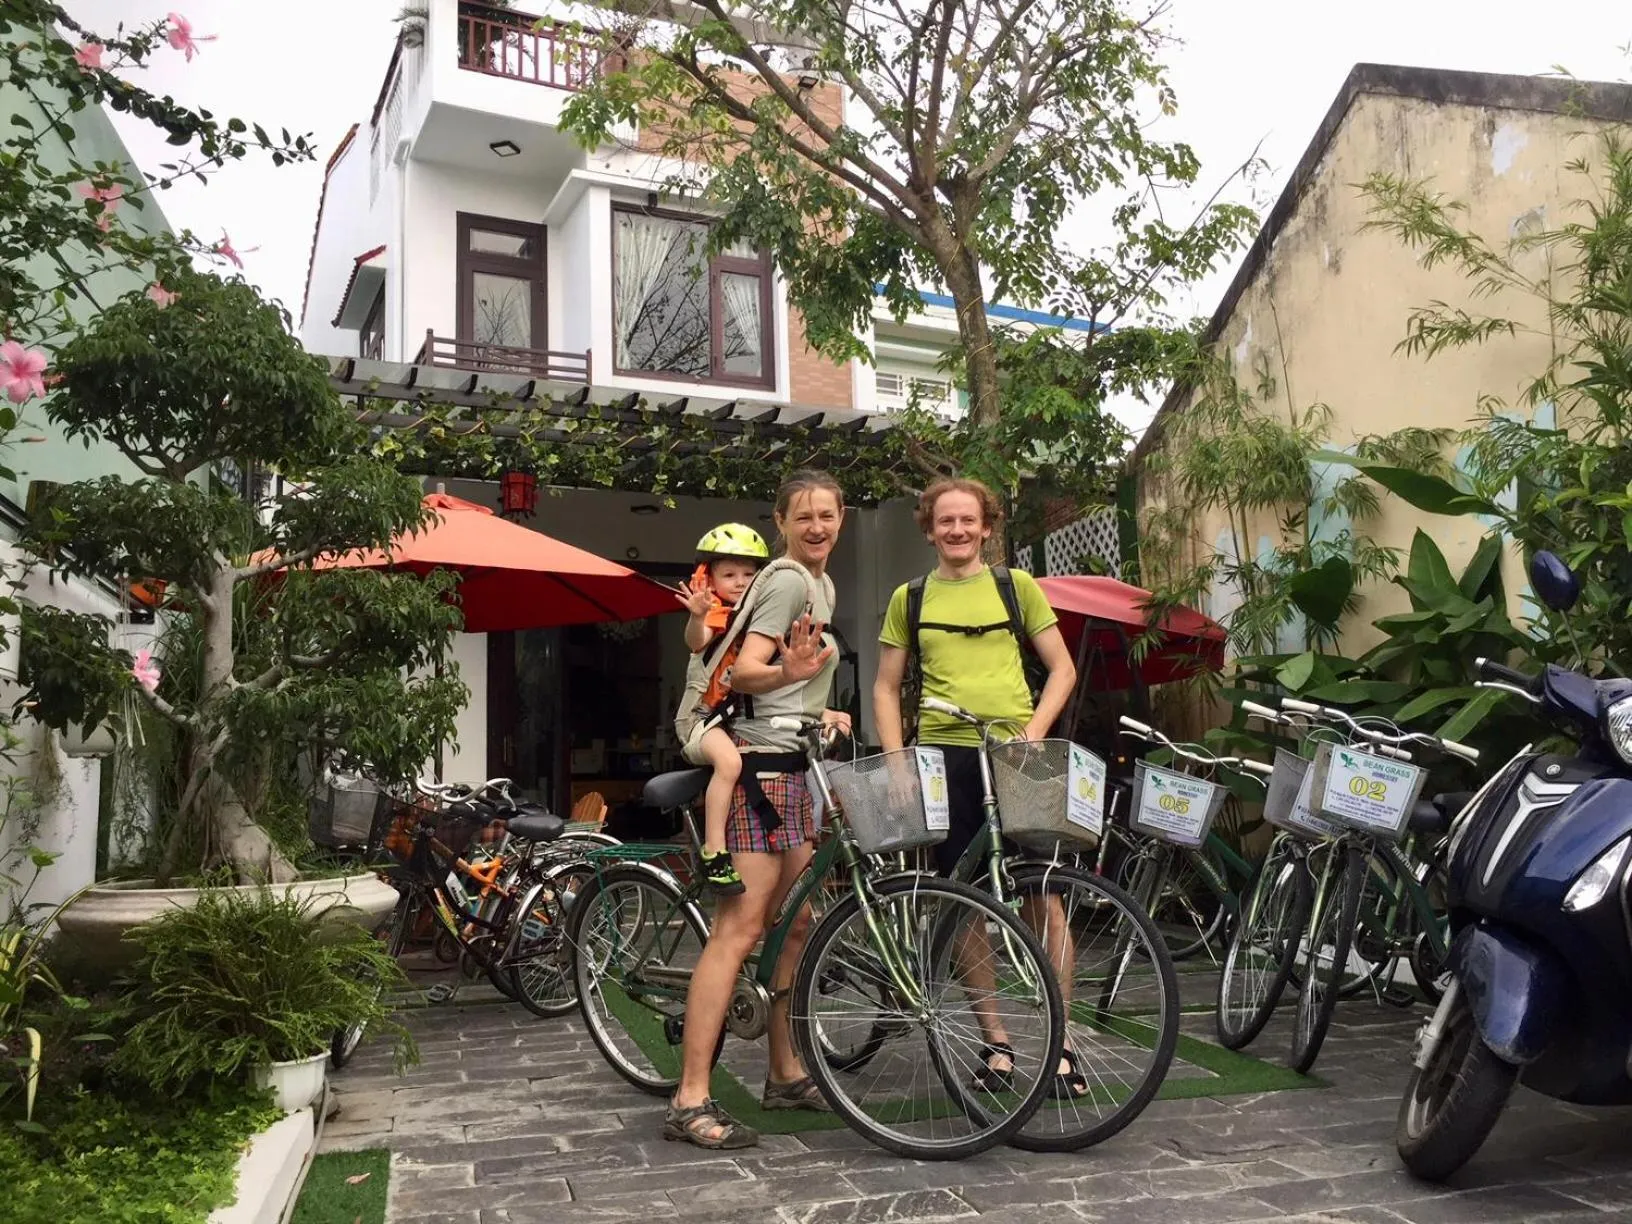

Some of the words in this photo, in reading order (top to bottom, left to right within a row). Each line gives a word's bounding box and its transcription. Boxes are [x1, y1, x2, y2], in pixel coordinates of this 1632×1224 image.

[1362, 760, 1384, 771] BEAN
[1385, 765, 1411, 778] GRASS
[1079, 777, 1097, 804] 04
[1349, 776, 1387, 802] 02
[1159, 793, 1190, 815] 05
